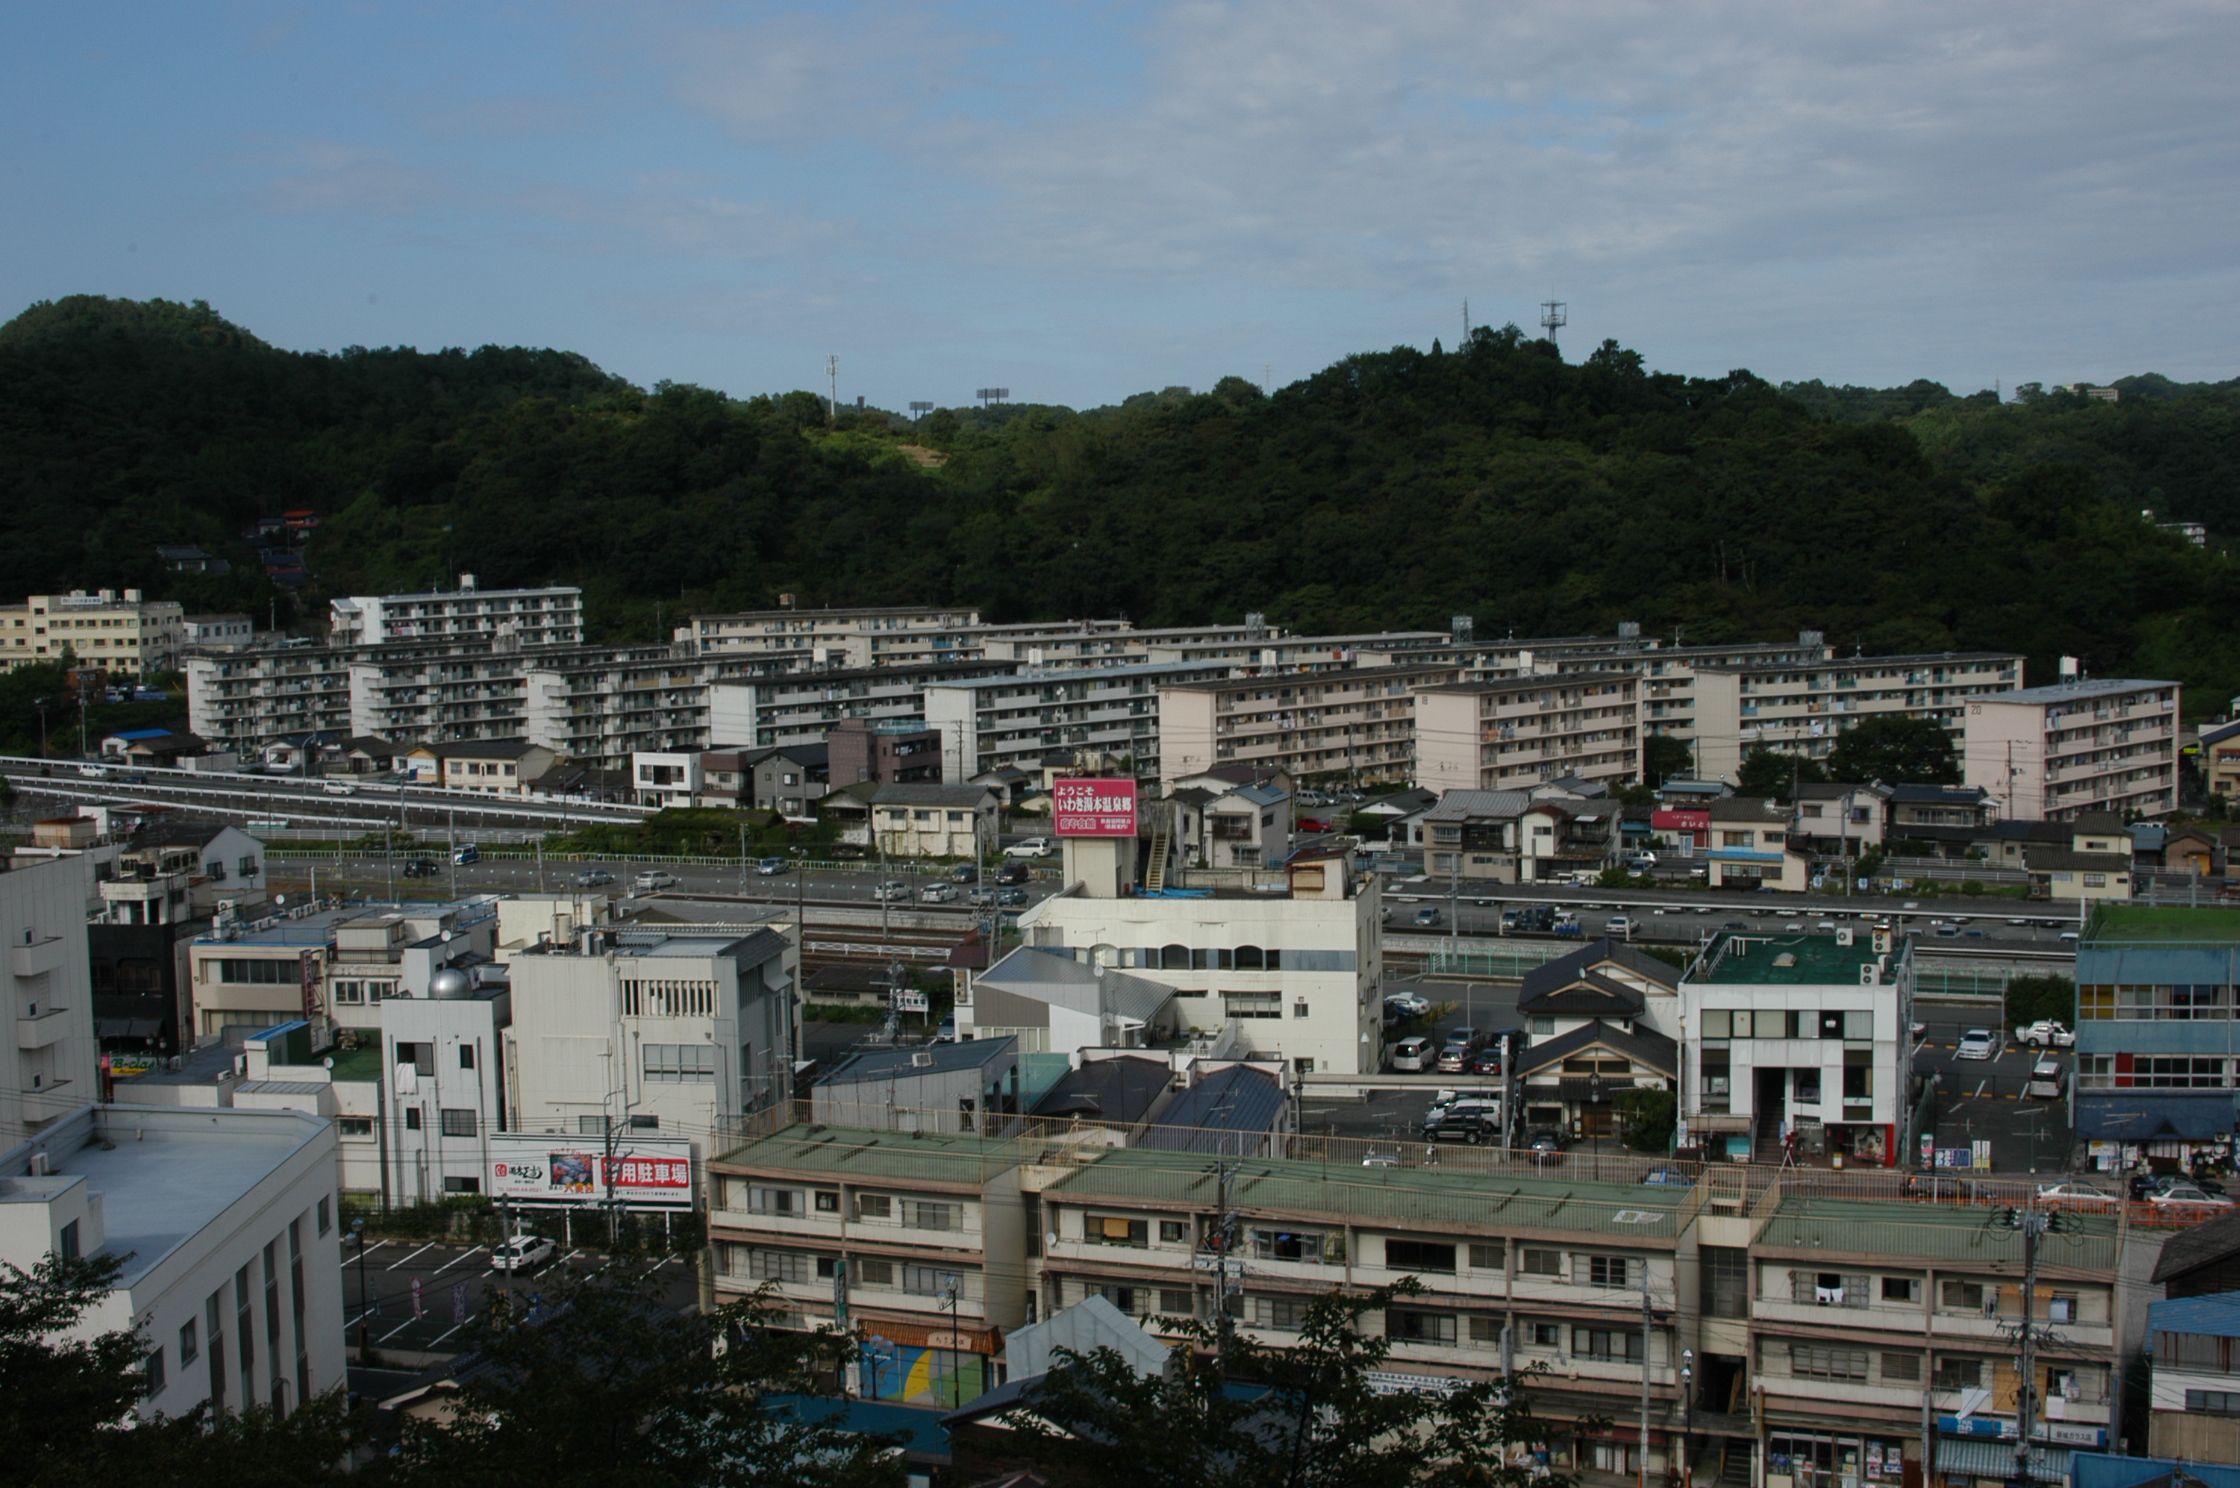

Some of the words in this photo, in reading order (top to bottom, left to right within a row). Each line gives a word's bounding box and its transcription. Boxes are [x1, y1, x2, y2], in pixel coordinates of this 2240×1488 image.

[1057, 785, 1095, 797] ようこそ
[1058, 796, 1132, 813] いわき湯本温泉郷
